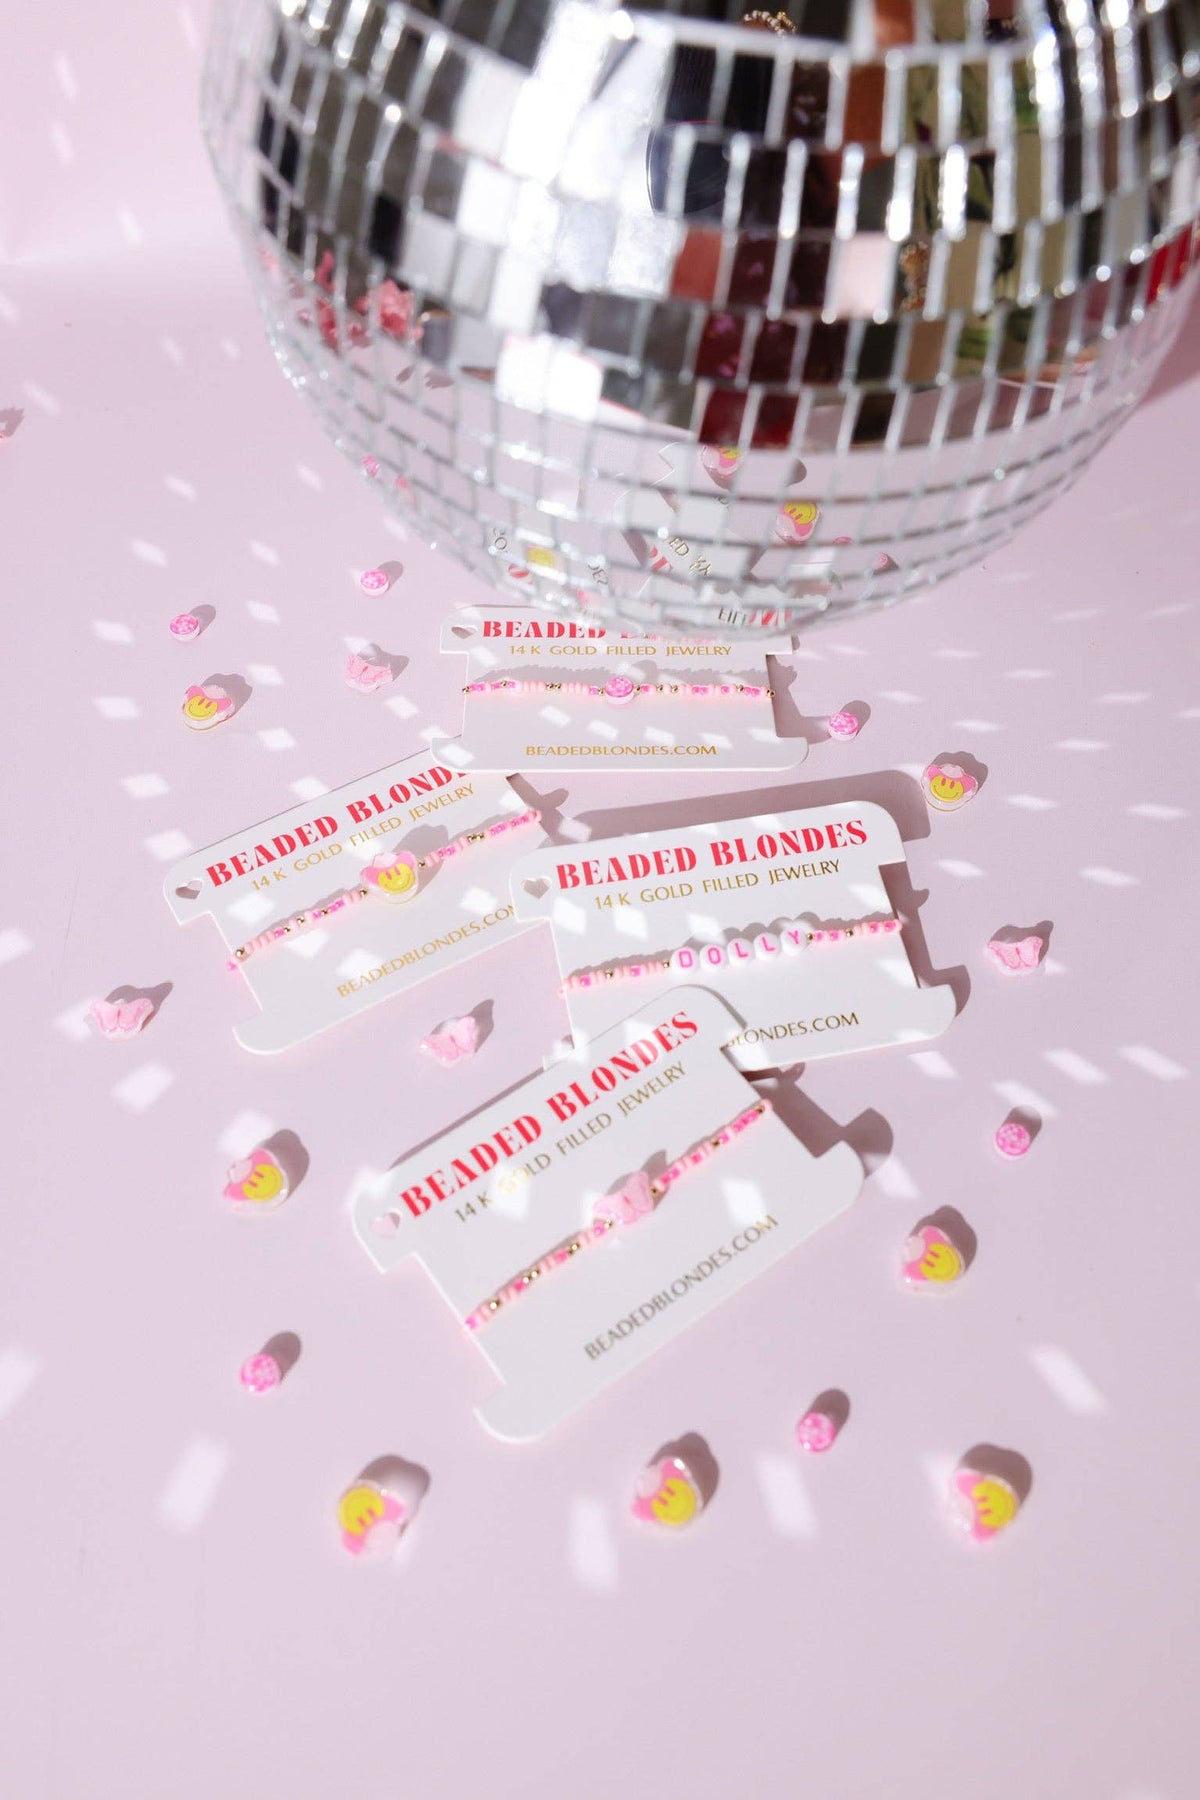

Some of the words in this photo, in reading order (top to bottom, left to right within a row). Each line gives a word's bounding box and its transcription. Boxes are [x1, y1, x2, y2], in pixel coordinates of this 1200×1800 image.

[483, 621, 606, 638] BEADED
[550, 646, 597, 655] GOLD
[607, 646, 656, 655] FILLED
[667, 646, 731, 656] JEWELRY
[526, 745, 717, 756] BEADEDBLONDES.COM
[207, 816, 338, 886] BEADED
[347, 767, 468, 823] BLOND
[293, 844, 342, 871] GOLD
[350, 818, 402, 846] FILLED
[409, 783, 473, 821] JEWELRY
[556, 847, 697, 889] BEADED
[710, 820, 867, 866] BLONDES
[640, 883, 694, 903] GOLD
[702, 873, 759, 893] FILLED
[768, 859, 840, 886] JEWELRY
[678, 929, 803, 969] DOLLY
[401, 1115, 542, 1217] BEADED
[546, 1012, 698, 1122] BLONDES
[498, 1153, 552, 1195] GOLD
[556, 1113, 611, 1155] FILLED
[617, 1061, 685, 1117] JEWELRY
[584, 1215, 778, 1358] BEADEDBLONDES.COM
